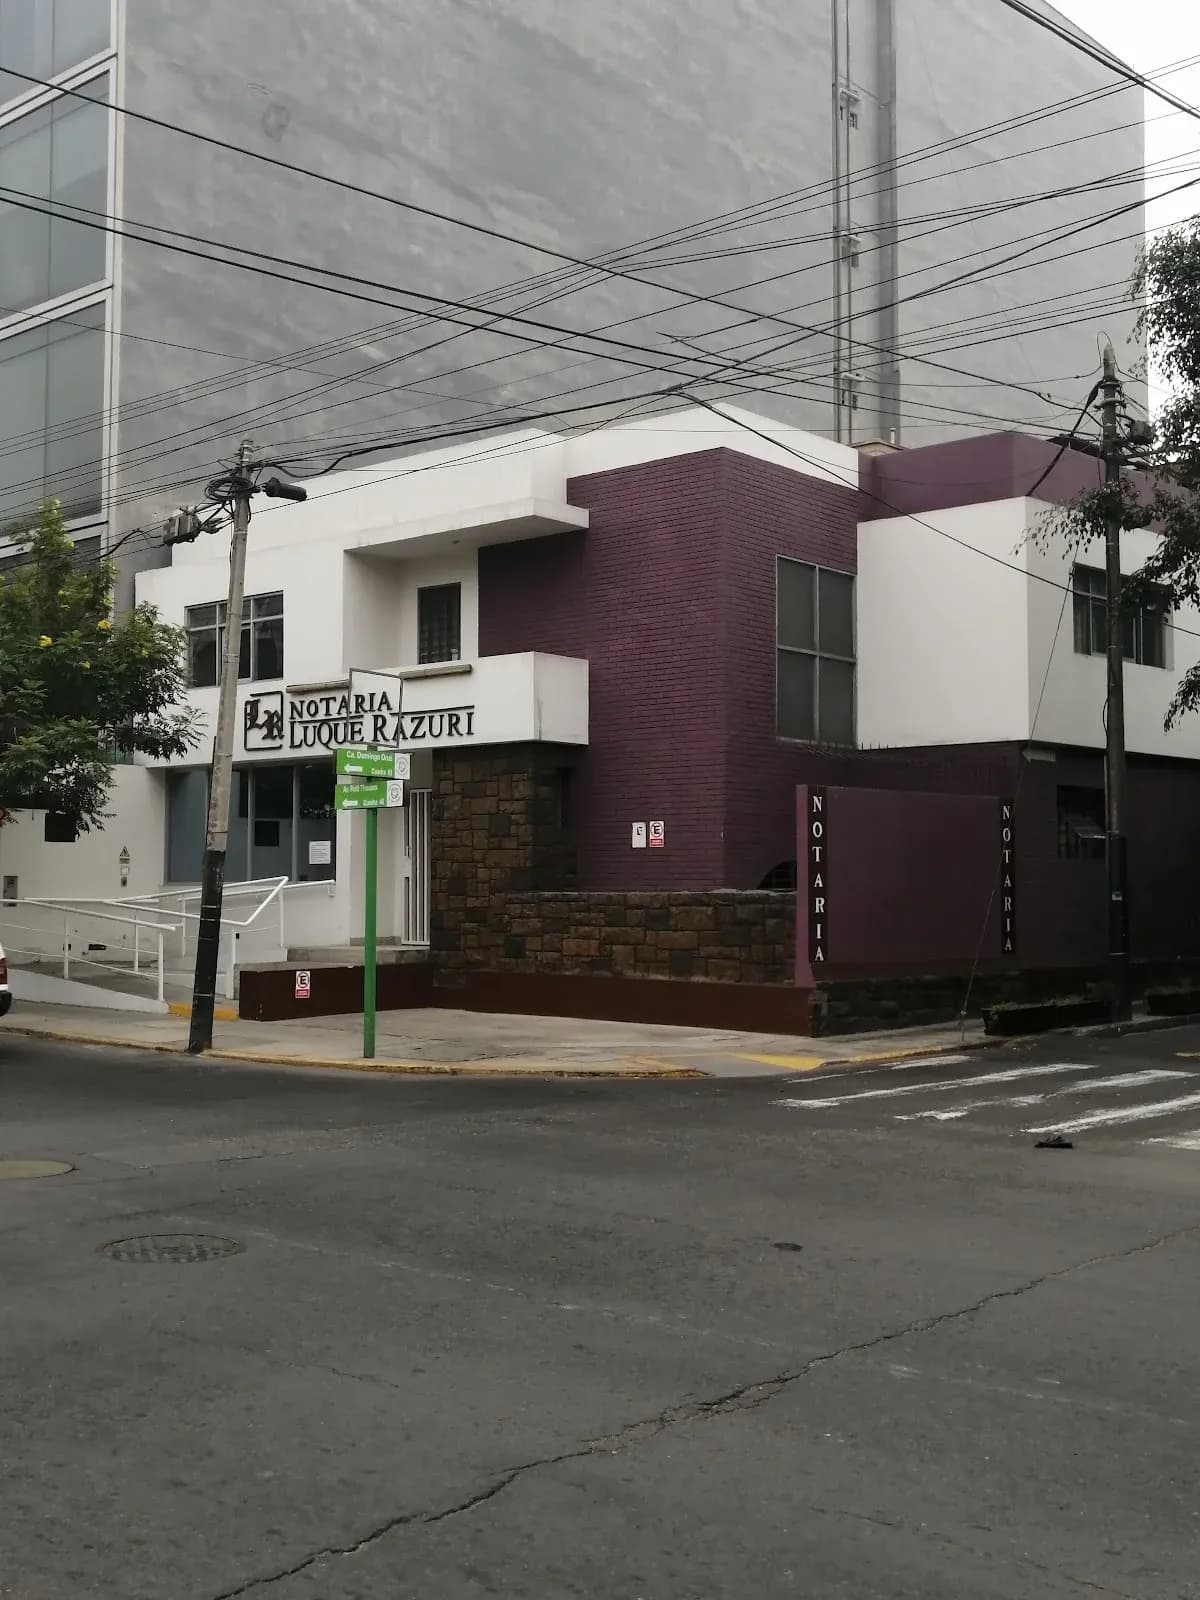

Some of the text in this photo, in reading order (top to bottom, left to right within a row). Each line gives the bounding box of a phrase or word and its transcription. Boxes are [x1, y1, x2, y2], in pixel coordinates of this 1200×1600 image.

[289, 691, 392, 720] NOTARIA
[289, 719, 364, 750] LUQUE
[812, 795, 825, 962] NOTARIA
[1002, 805, 1012, 951] NOTARIA
